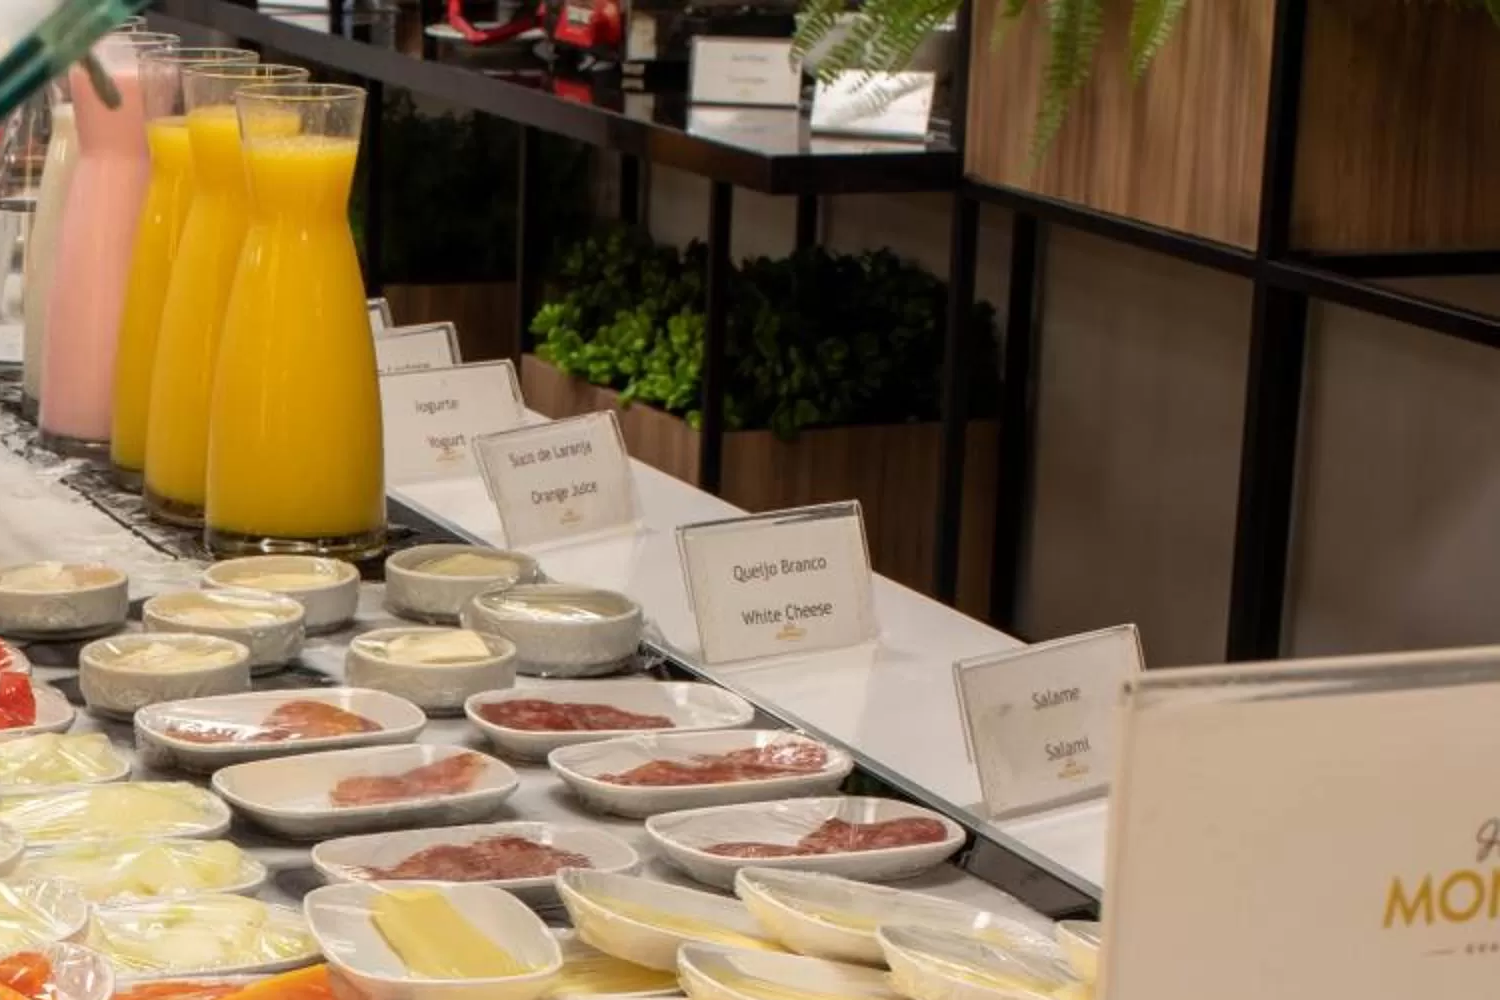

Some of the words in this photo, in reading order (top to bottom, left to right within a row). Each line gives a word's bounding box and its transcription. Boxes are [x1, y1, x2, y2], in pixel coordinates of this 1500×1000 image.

[531, 487, 569, 504] Orange
[733, 563, 778, 583] Queijo
[781, 556, 827, 574] Branco
[741, 609, 782, 625] White
[785, 602, 833, 620] Cheese
[1032, 687, 1081, 709] Salame
[1045, 737, 1092, 761] Salami
[1383, 868, 1500, 929] MO
